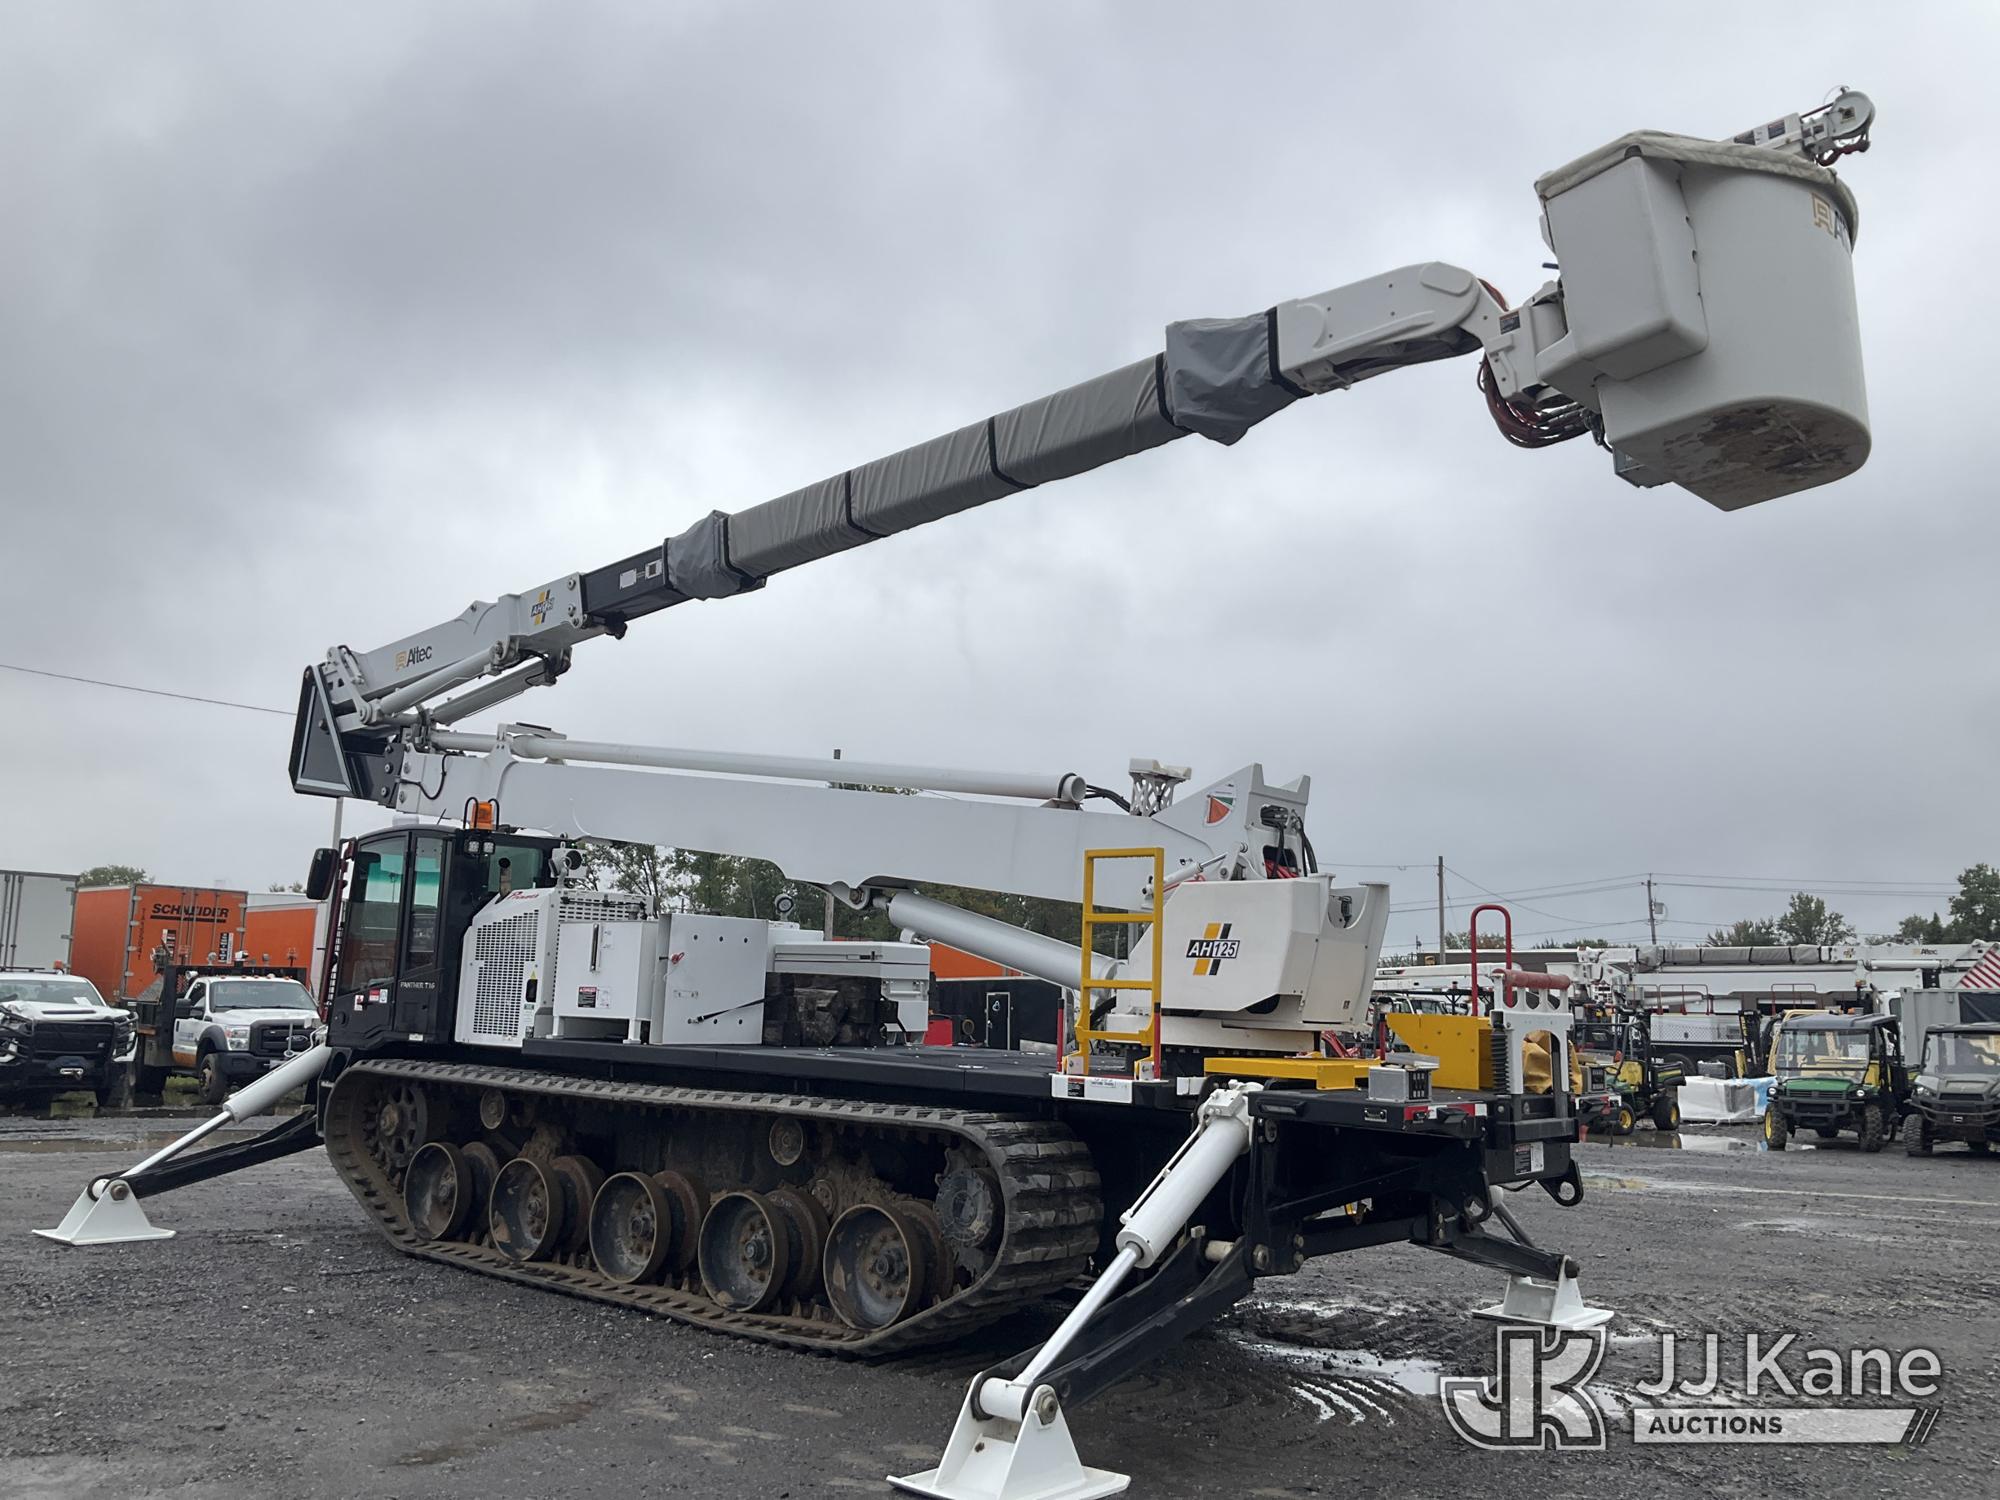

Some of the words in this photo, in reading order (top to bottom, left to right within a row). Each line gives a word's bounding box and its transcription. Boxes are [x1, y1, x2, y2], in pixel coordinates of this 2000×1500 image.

[406, 646, 432, 667] Altec
[152, 903, 230, 918] SCHNEIDER
[1188, 941, 1236, 957] AH125
